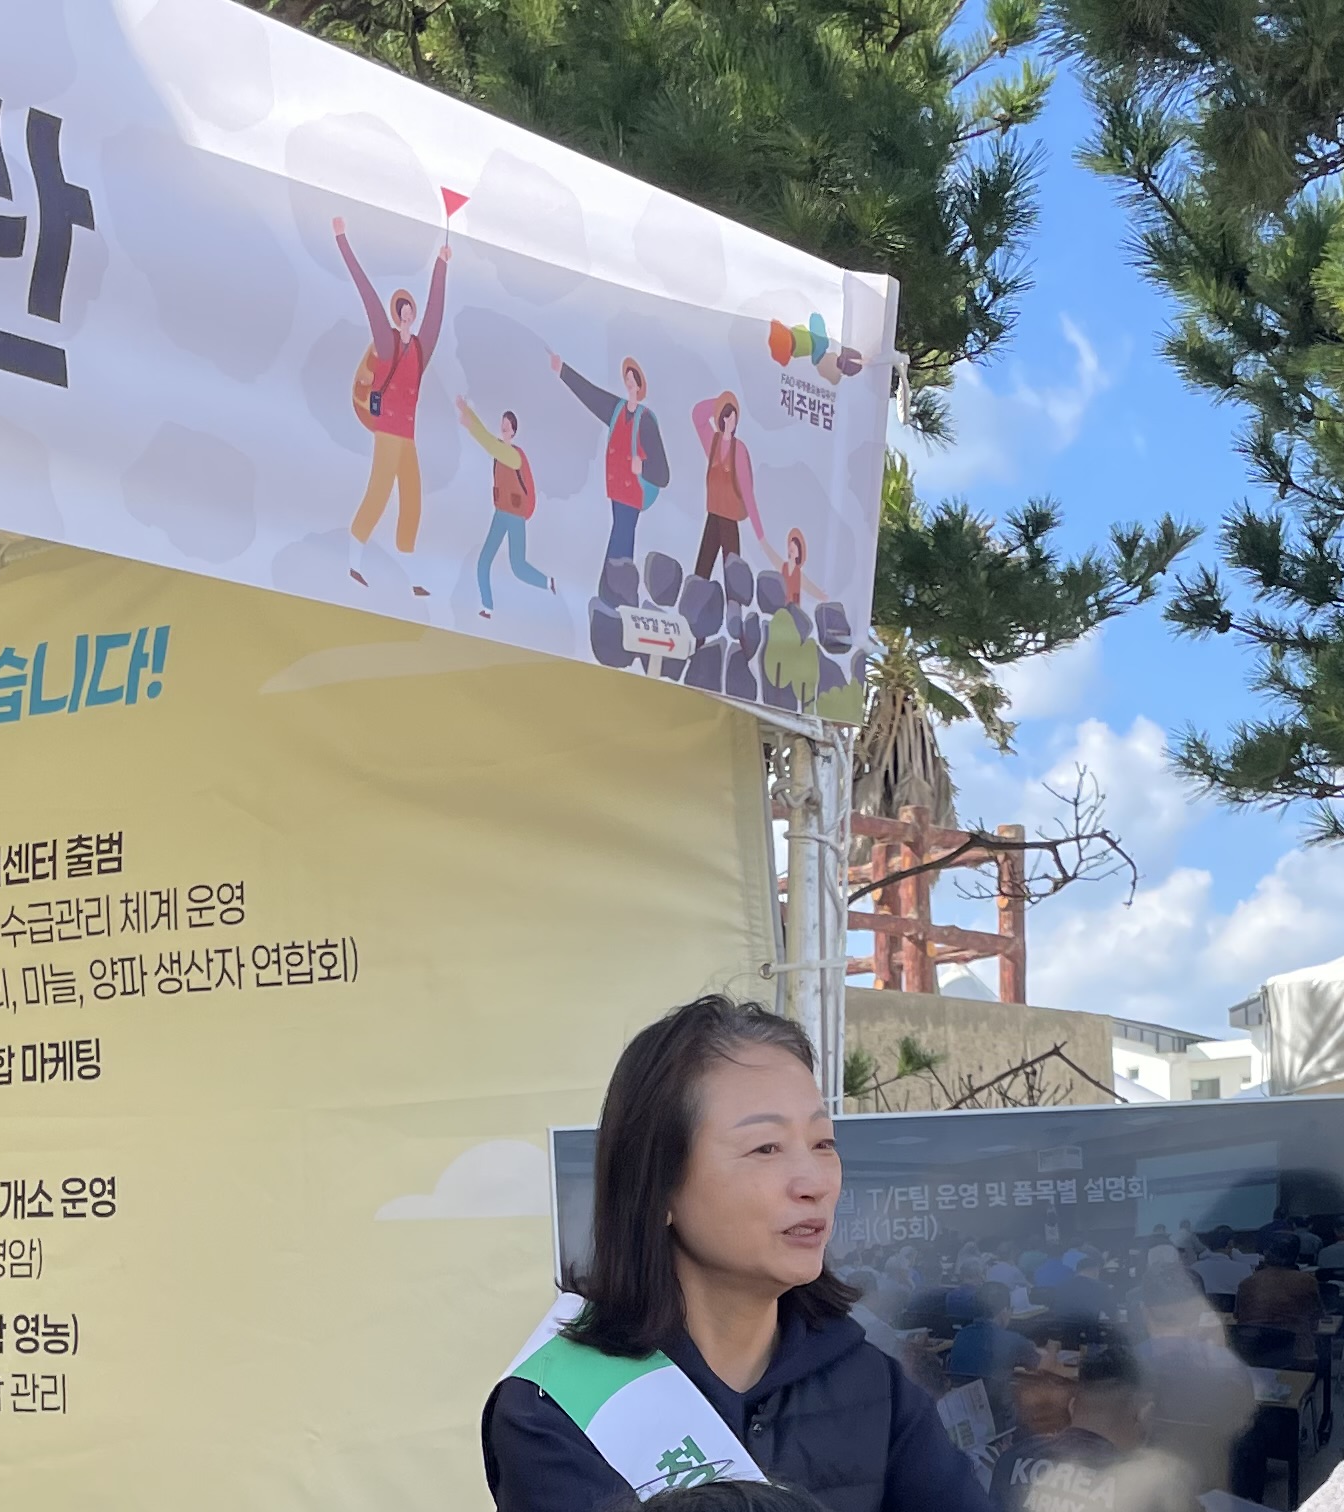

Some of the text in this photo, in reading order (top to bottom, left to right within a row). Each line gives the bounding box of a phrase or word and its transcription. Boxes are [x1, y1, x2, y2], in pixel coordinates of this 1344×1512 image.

[65, 830, 124, 880] 출범
[0, 893, 112, 949] 수급관리
[119, 886, 180, 935] 체계
[186, 880, 246, 930] 운영
[21, 961, 85, 1010] 마늘,
[89, 953, 149, 1001] 양파
[153, 944, 247, 996] 생산자
[251, 935, 359, 990] 연합회)
[21, 1036, 103, 1084] 마케팅
[60, 1175, 117, 1219] 운영
[868, 1185, 930, 1215] T/F팀
[935, 1181, 980, 1211] 운영
[985, 1180, 1008, 1208] 및
[1011, 1178, 1078, 1207] 품목별
[1082, 1174, 1154, 1206] 설명회,
[13, 1312, 80, 1356] 영농)
[10, 1372, 68, 1415] 관리
[1009, 1456, 1117, 1510] KOREA
